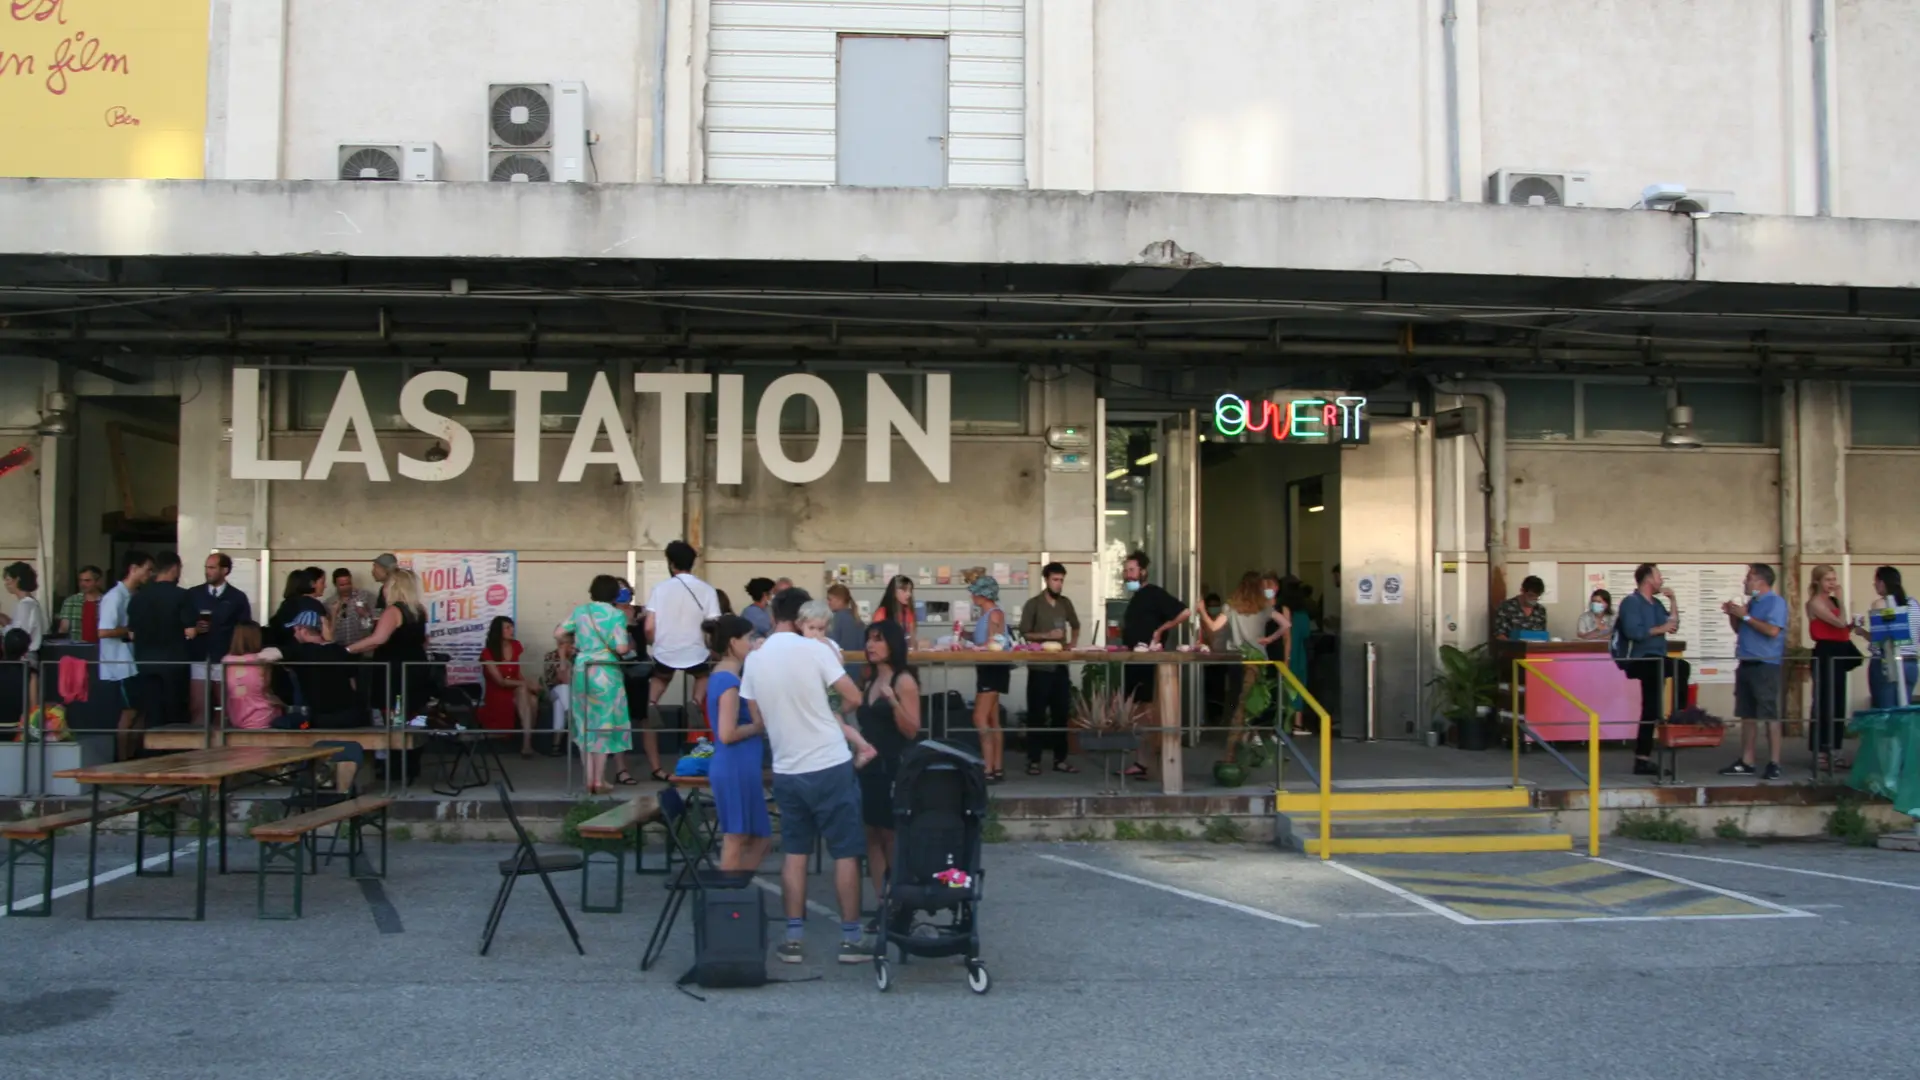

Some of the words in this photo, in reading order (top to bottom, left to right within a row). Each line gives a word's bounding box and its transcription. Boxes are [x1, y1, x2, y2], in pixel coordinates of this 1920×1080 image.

[46, 31, 129, 95] film
[105, 105, 141, 127] Ben
[1215, 393, 1367, 440] OUVERT
[421, 558, 475, 593] VOILÀ
